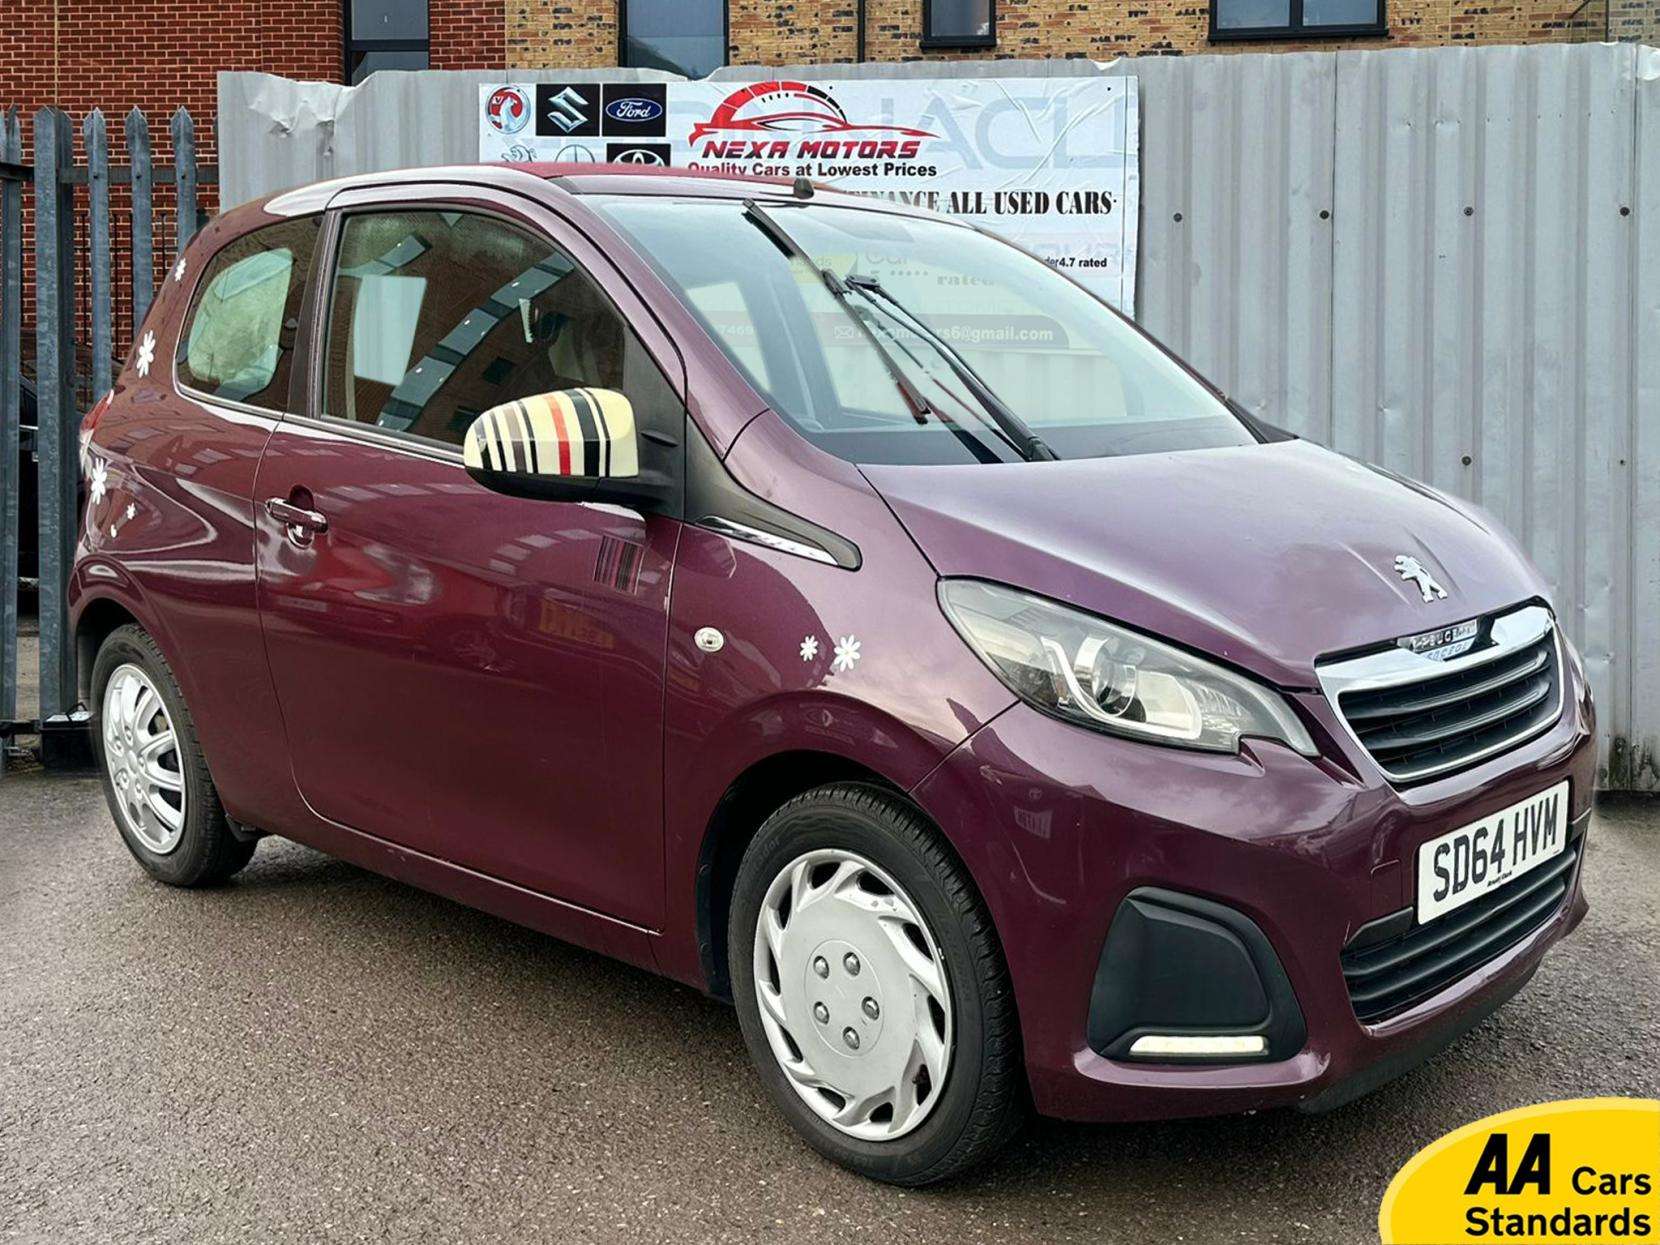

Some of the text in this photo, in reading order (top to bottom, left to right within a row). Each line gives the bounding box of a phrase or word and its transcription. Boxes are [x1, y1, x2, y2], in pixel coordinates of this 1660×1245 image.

[616, 101, 651, 118] Ford
[702, 141, 921, 159] NEXA MOTORS
[688, 161, 937, 177] Quality Cars at Lowest Prices
[947, 191, 987, 214] ALL
[994, 191, 1050, 215] USED
[1078, 257, 1107, 268] rated
[1433, 793, 1558, 902] SD64 HVM
